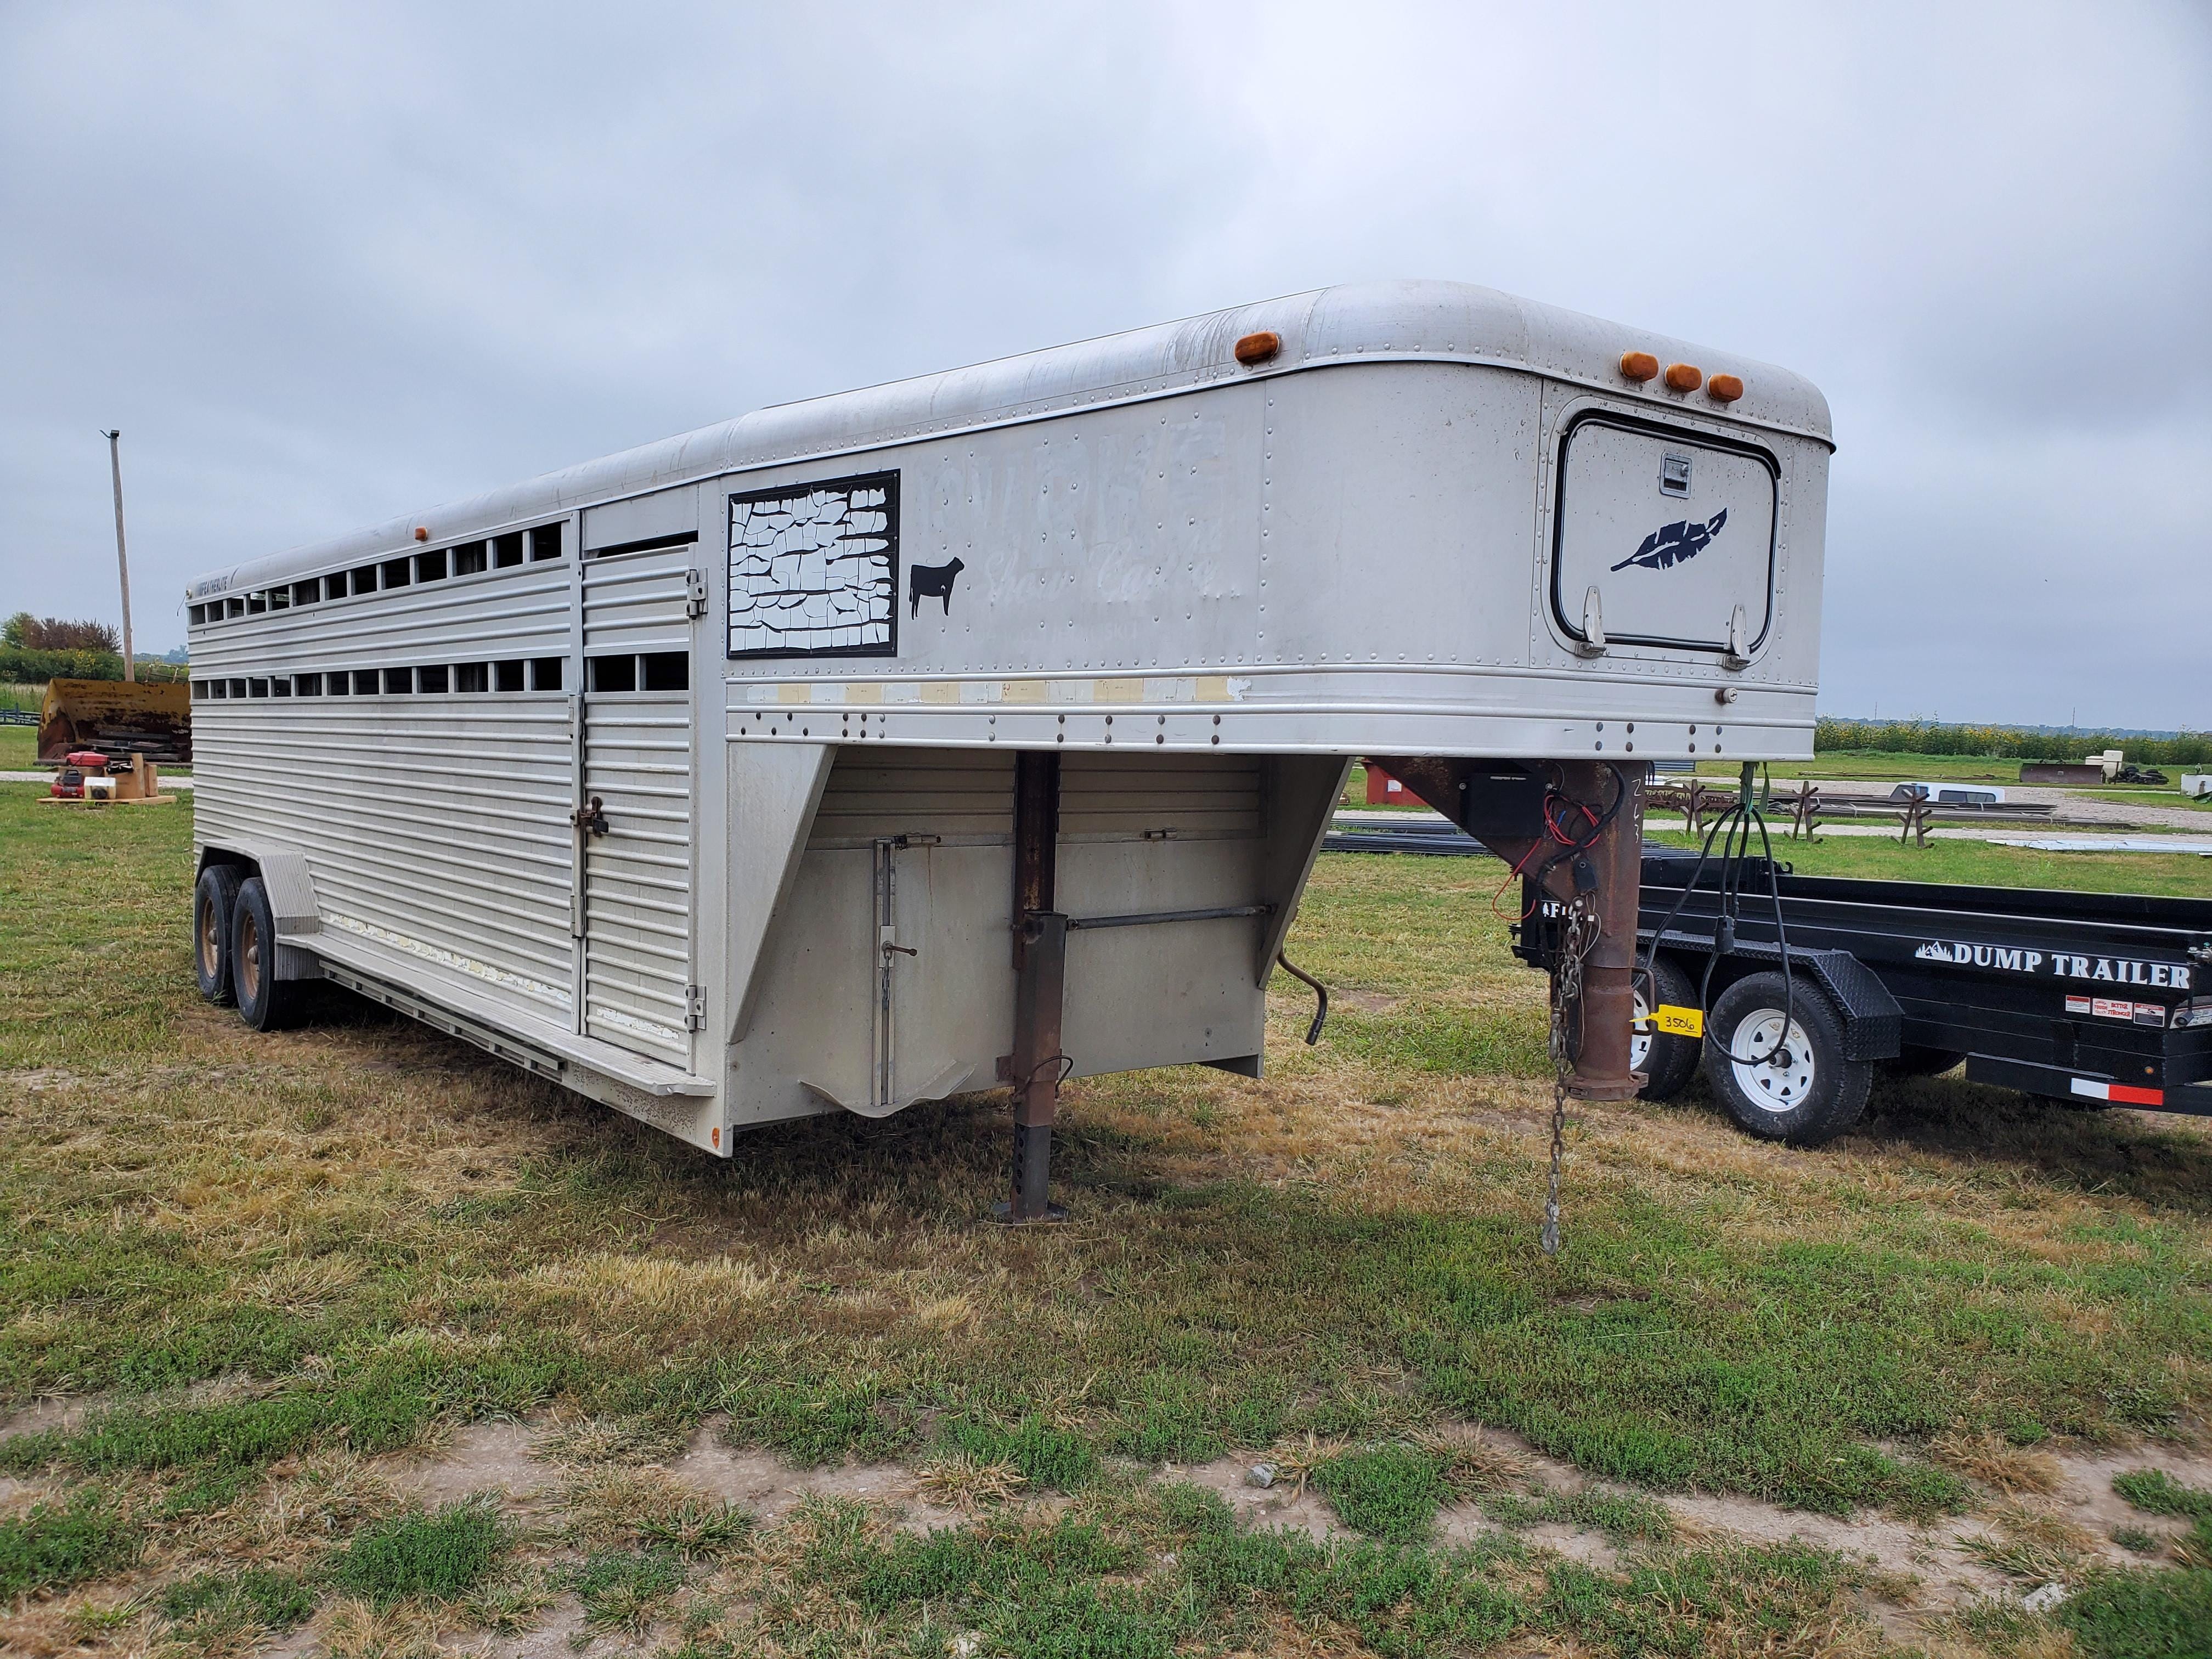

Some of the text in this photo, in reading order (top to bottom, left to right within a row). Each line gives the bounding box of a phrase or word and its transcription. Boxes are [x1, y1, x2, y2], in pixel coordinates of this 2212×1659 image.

[1953, 943, 2190, 989] DUMP TRAILER
[1665, 1016, 1695, 1030] 3506
